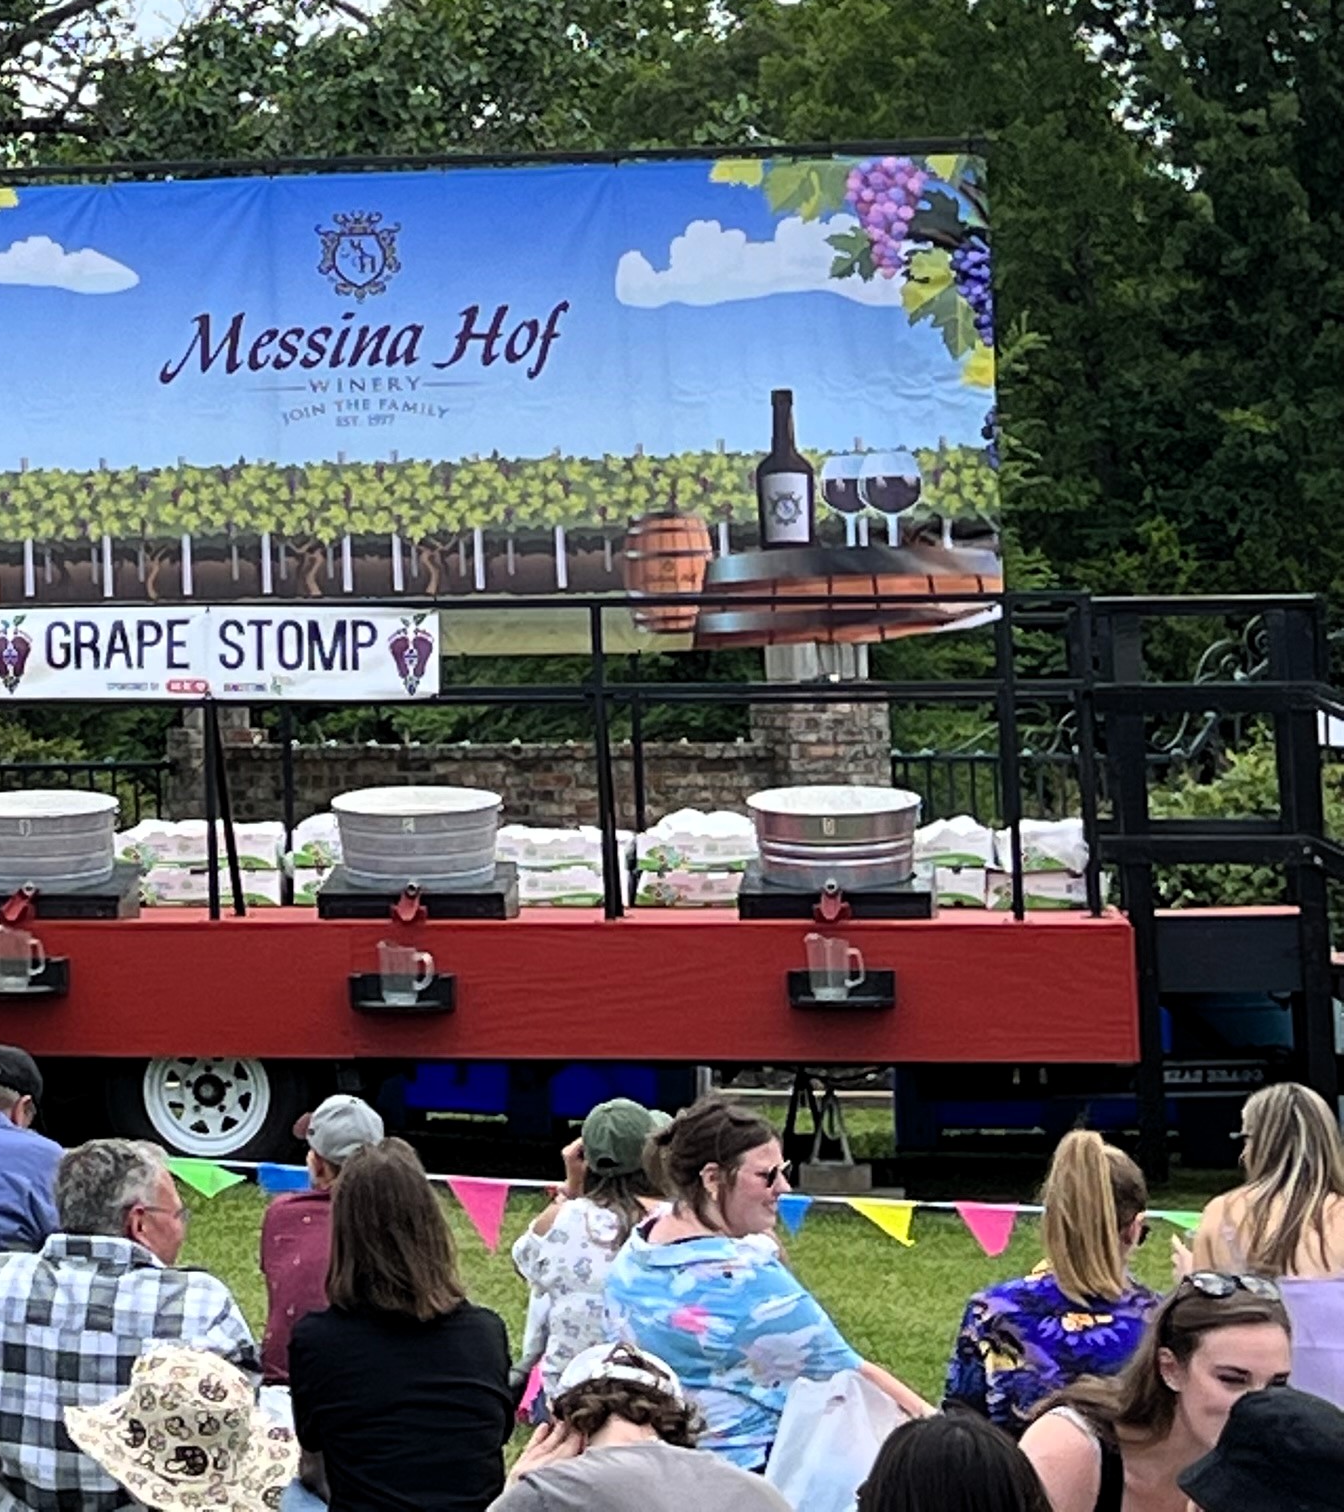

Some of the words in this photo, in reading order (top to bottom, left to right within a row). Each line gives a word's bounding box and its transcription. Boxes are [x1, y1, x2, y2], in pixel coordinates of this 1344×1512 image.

[160, 312, 424, 384] Messina
[432, 300, 570, 379] Hof
[309, 375, 421, 393] WINERY
[282, 403, 326, 425] JOIN
[334, 399, 370, 413] THE
[379, 399, 450, 419] FAMILY
[44, 618, 190, 670] GRAPE
[218, 618, 378, 671] STOMP
